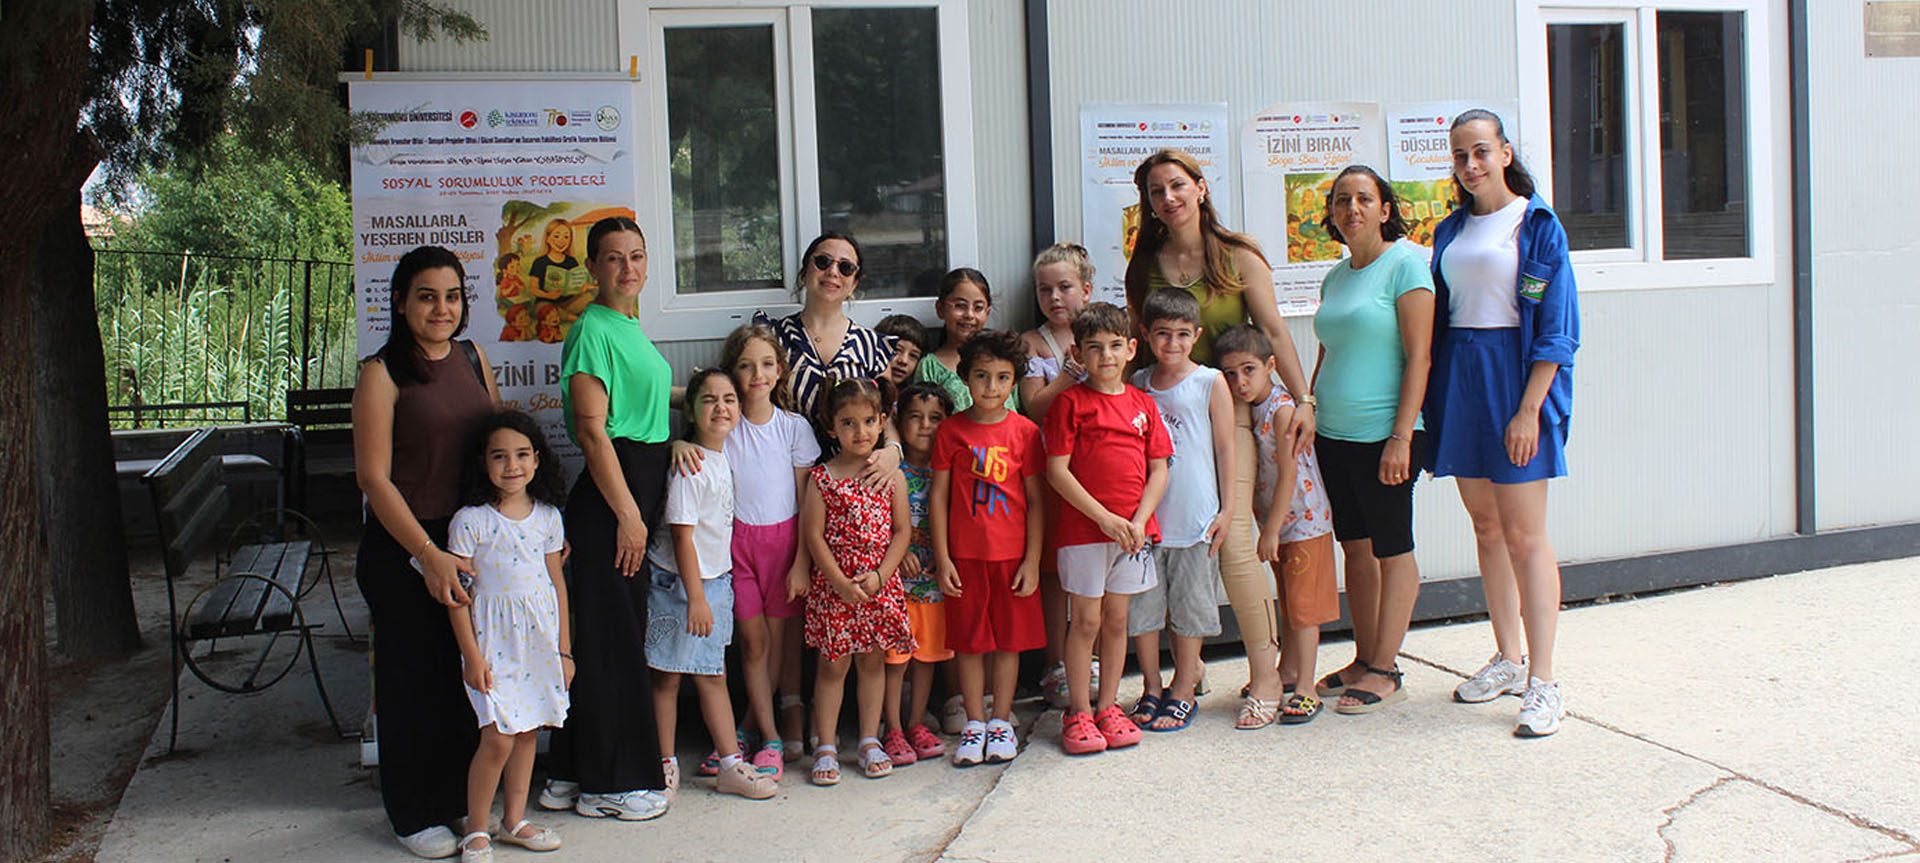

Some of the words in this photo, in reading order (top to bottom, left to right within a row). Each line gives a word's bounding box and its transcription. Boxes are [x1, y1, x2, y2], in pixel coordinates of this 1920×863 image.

[1267, 134, 1301, 153] İZİNİ
[1306, 136, 1352, 152] BIRAK
[1401, 137, 1448, 154] DÜŞLER
[382, 177, 432, 190] SOSYAL
[439, 175, 524, 189] SORUMLULUK
[530, 171, 606, 187] PROJELERİ
[371, 214, 468, 229] MASALLARLA
[361, 231, 425, 248] YEŞEREN
[431, 229, 485, 246] DÜŞLER
[491, 360, 534, 387] ZİNİ
